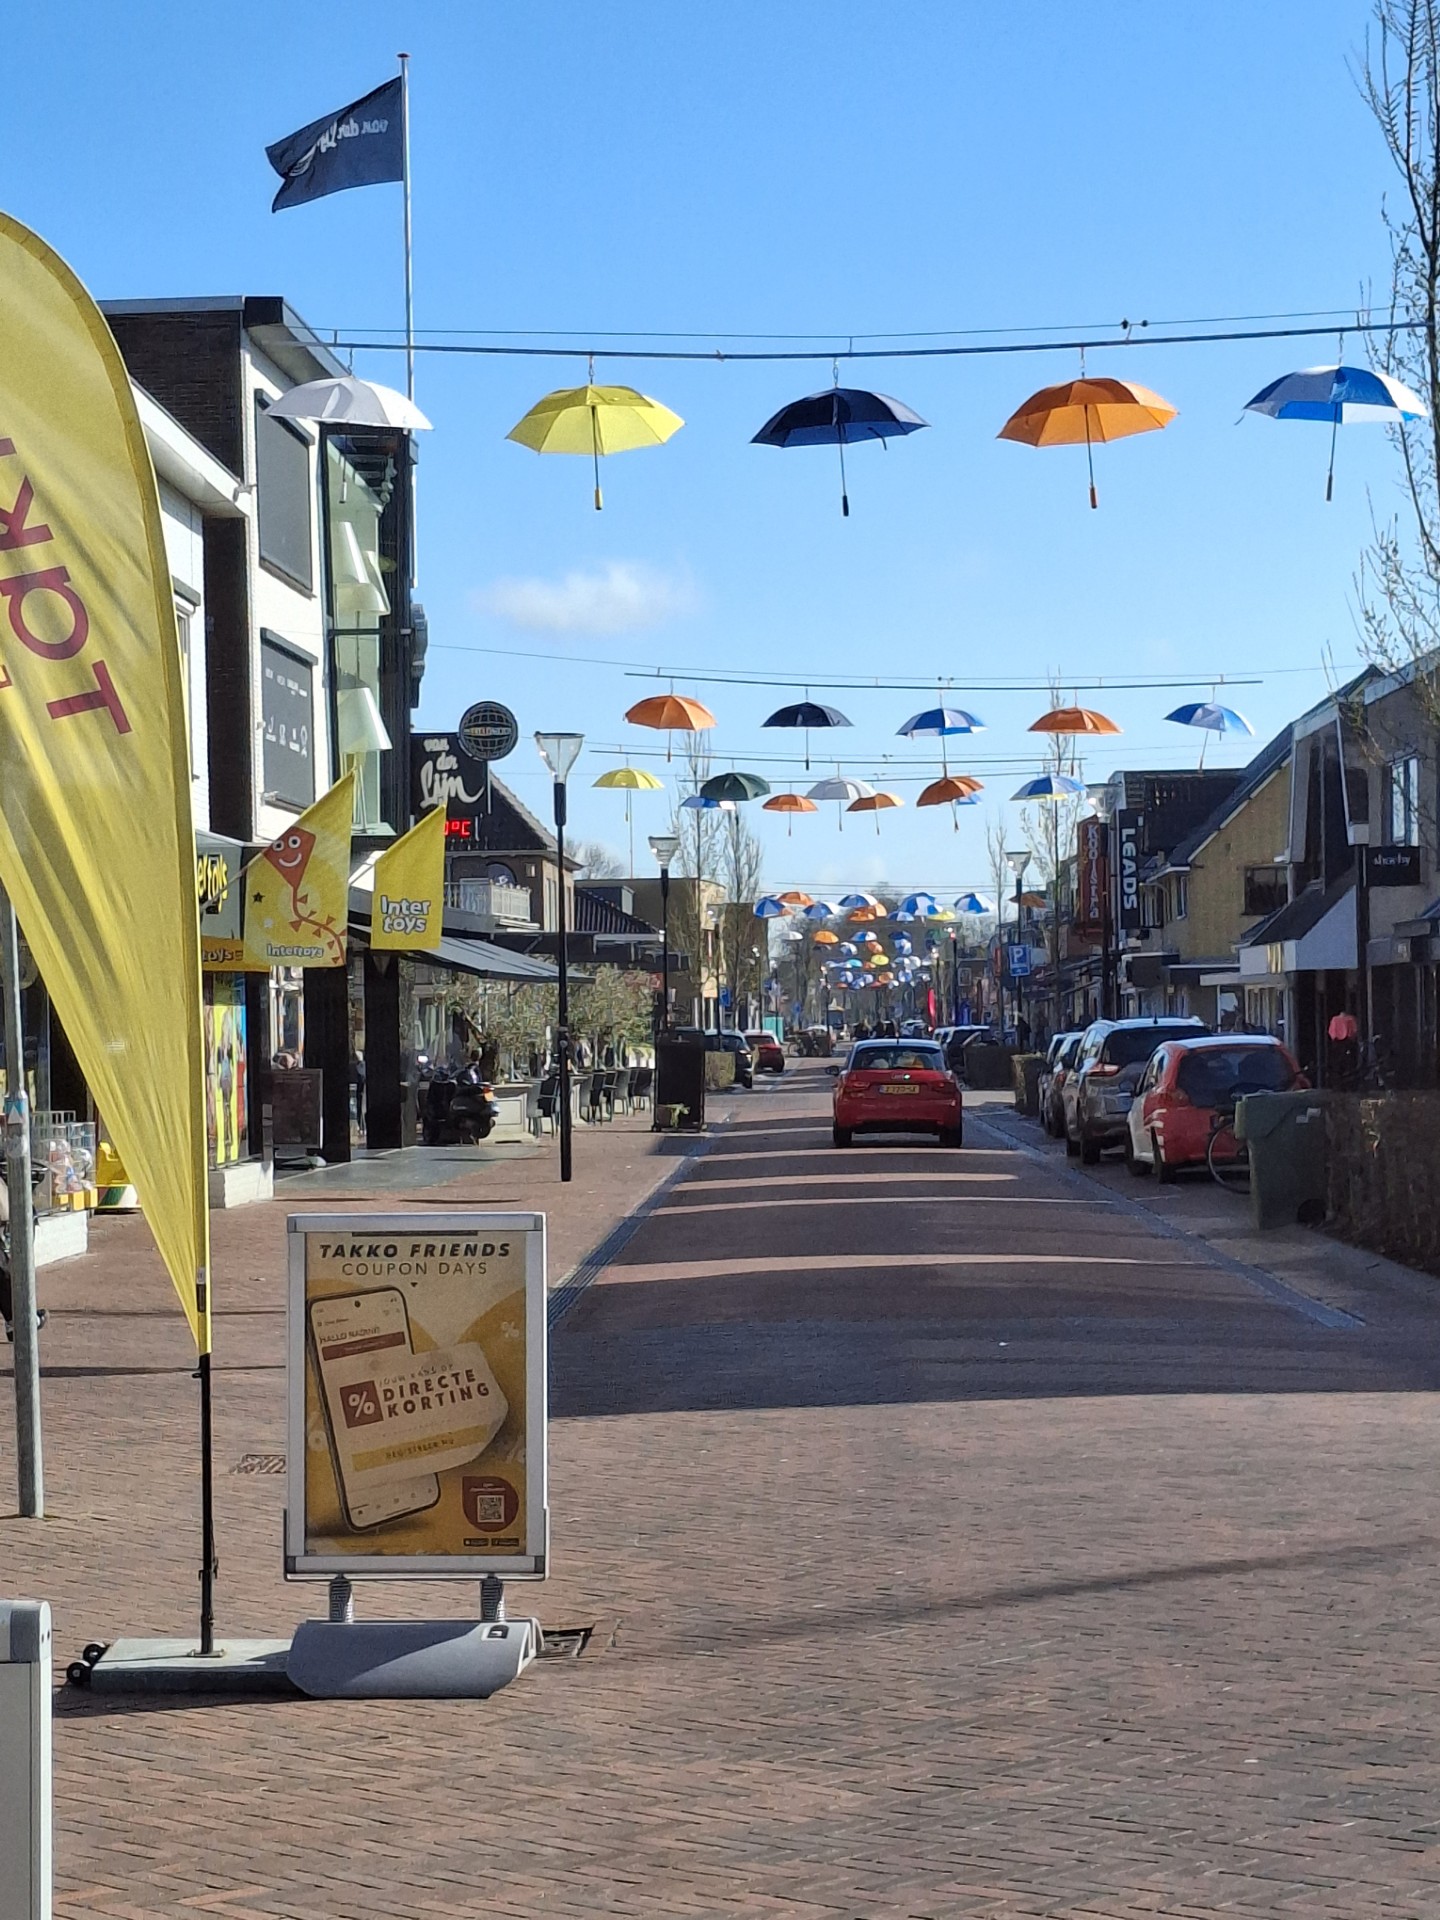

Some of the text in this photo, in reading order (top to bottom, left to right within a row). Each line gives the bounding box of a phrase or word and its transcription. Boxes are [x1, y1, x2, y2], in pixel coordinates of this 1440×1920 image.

[423, 737, 450, 753] van
[436, 751, 459, 771] der
[1121, 828, 1138, 910] LEADS
[380, 894, 431, 916] Inter
[382, 915, 428, 935] toys
[266, 942, 325, 959] Intertoys
[1013, 948, 1024, 962] P
[319, 1242, 511, 1258] TAKKO FRIENDS
[341, 1261, 488, 1276] COUPON DAYS
[382, 1368, 477, 1402] DIRECTE
[388, 1382, 490, 1418] KORTING
